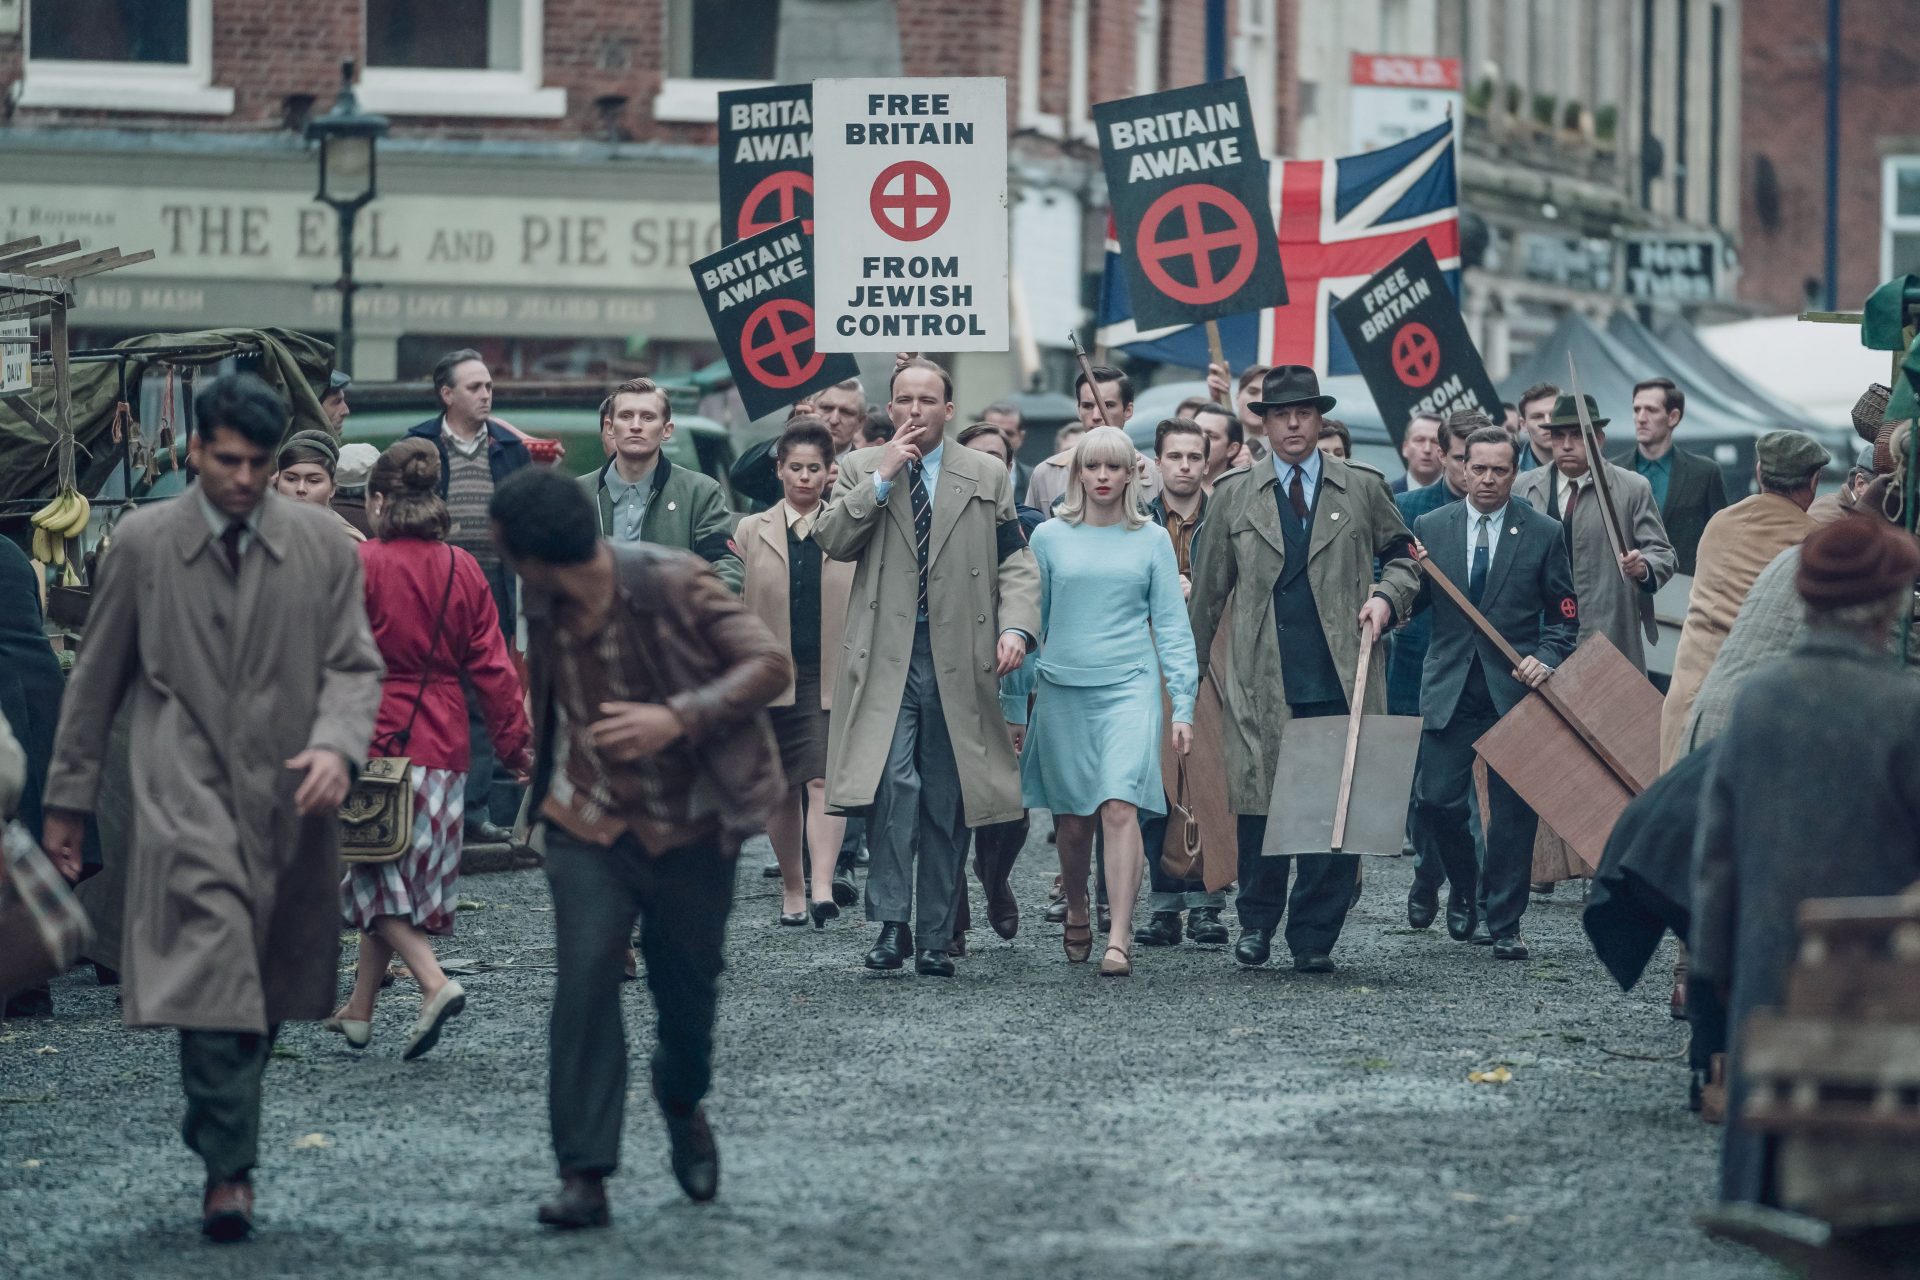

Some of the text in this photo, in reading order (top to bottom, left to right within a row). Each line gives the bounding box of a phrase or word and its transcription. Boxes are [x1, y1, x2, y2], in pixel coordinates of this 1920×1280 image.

[731, 98, 812, 131] BRITA
[868, 94, 950, 115] FREE
[845, 123, 974, 144] BRITAIN
[1109, 101, 1240, 150] BRITAIN
[734, 130, 813, 164] AWAK
[1127, 137, 1242, 184] AWAKE
[162, 205, 268, 256] THE
[428, 230, 495, 262] AND
[521, 214, 608, 266] PIE
[702, 232, 802, 291] BRITAIN
[862, 256, 959, 279] FROM
[85, 287, 133, 309] AND
[718, 257, 808, 313] AWAKE
[847, 284, 973, 308] JEWISH
[1362, 267, 1410, 313] FREE
[836, 314, 986, 337] CONTROL
[1360, 277, 1432, 343] BRITAIN
[1409, 374, 1463, 420] FROM
